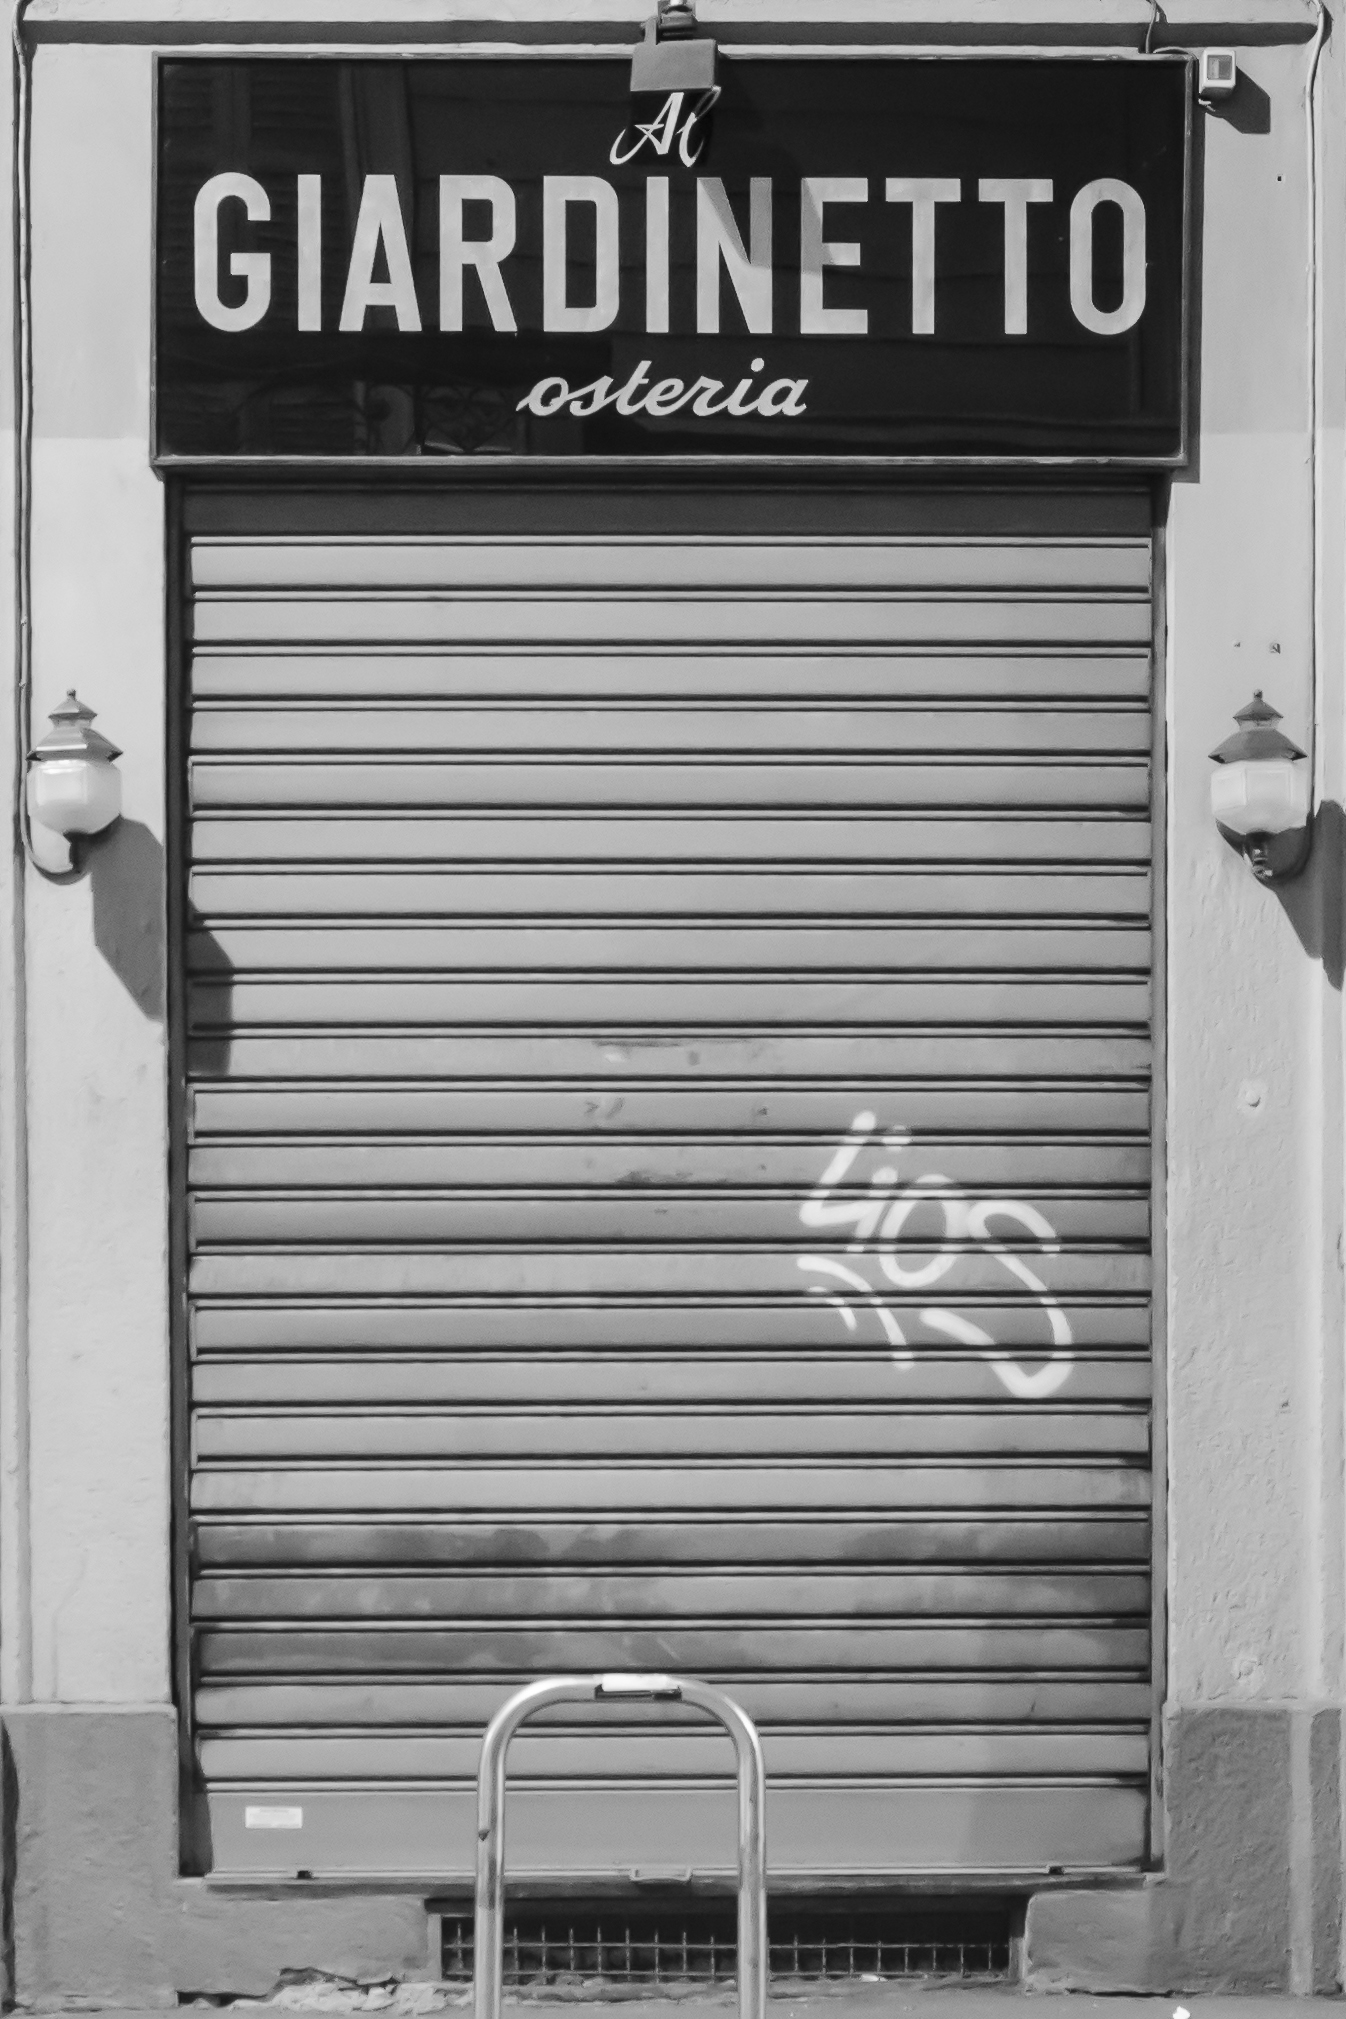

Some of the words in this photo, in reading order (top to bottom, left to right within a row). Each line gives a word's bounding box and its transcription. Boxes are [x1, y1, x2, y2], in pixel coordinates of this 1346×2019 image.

[609, 86, 722, 168] Al
[192, 171, 1150, 336] GIARDINETTO
[514, 357, 809, 417] osteria
